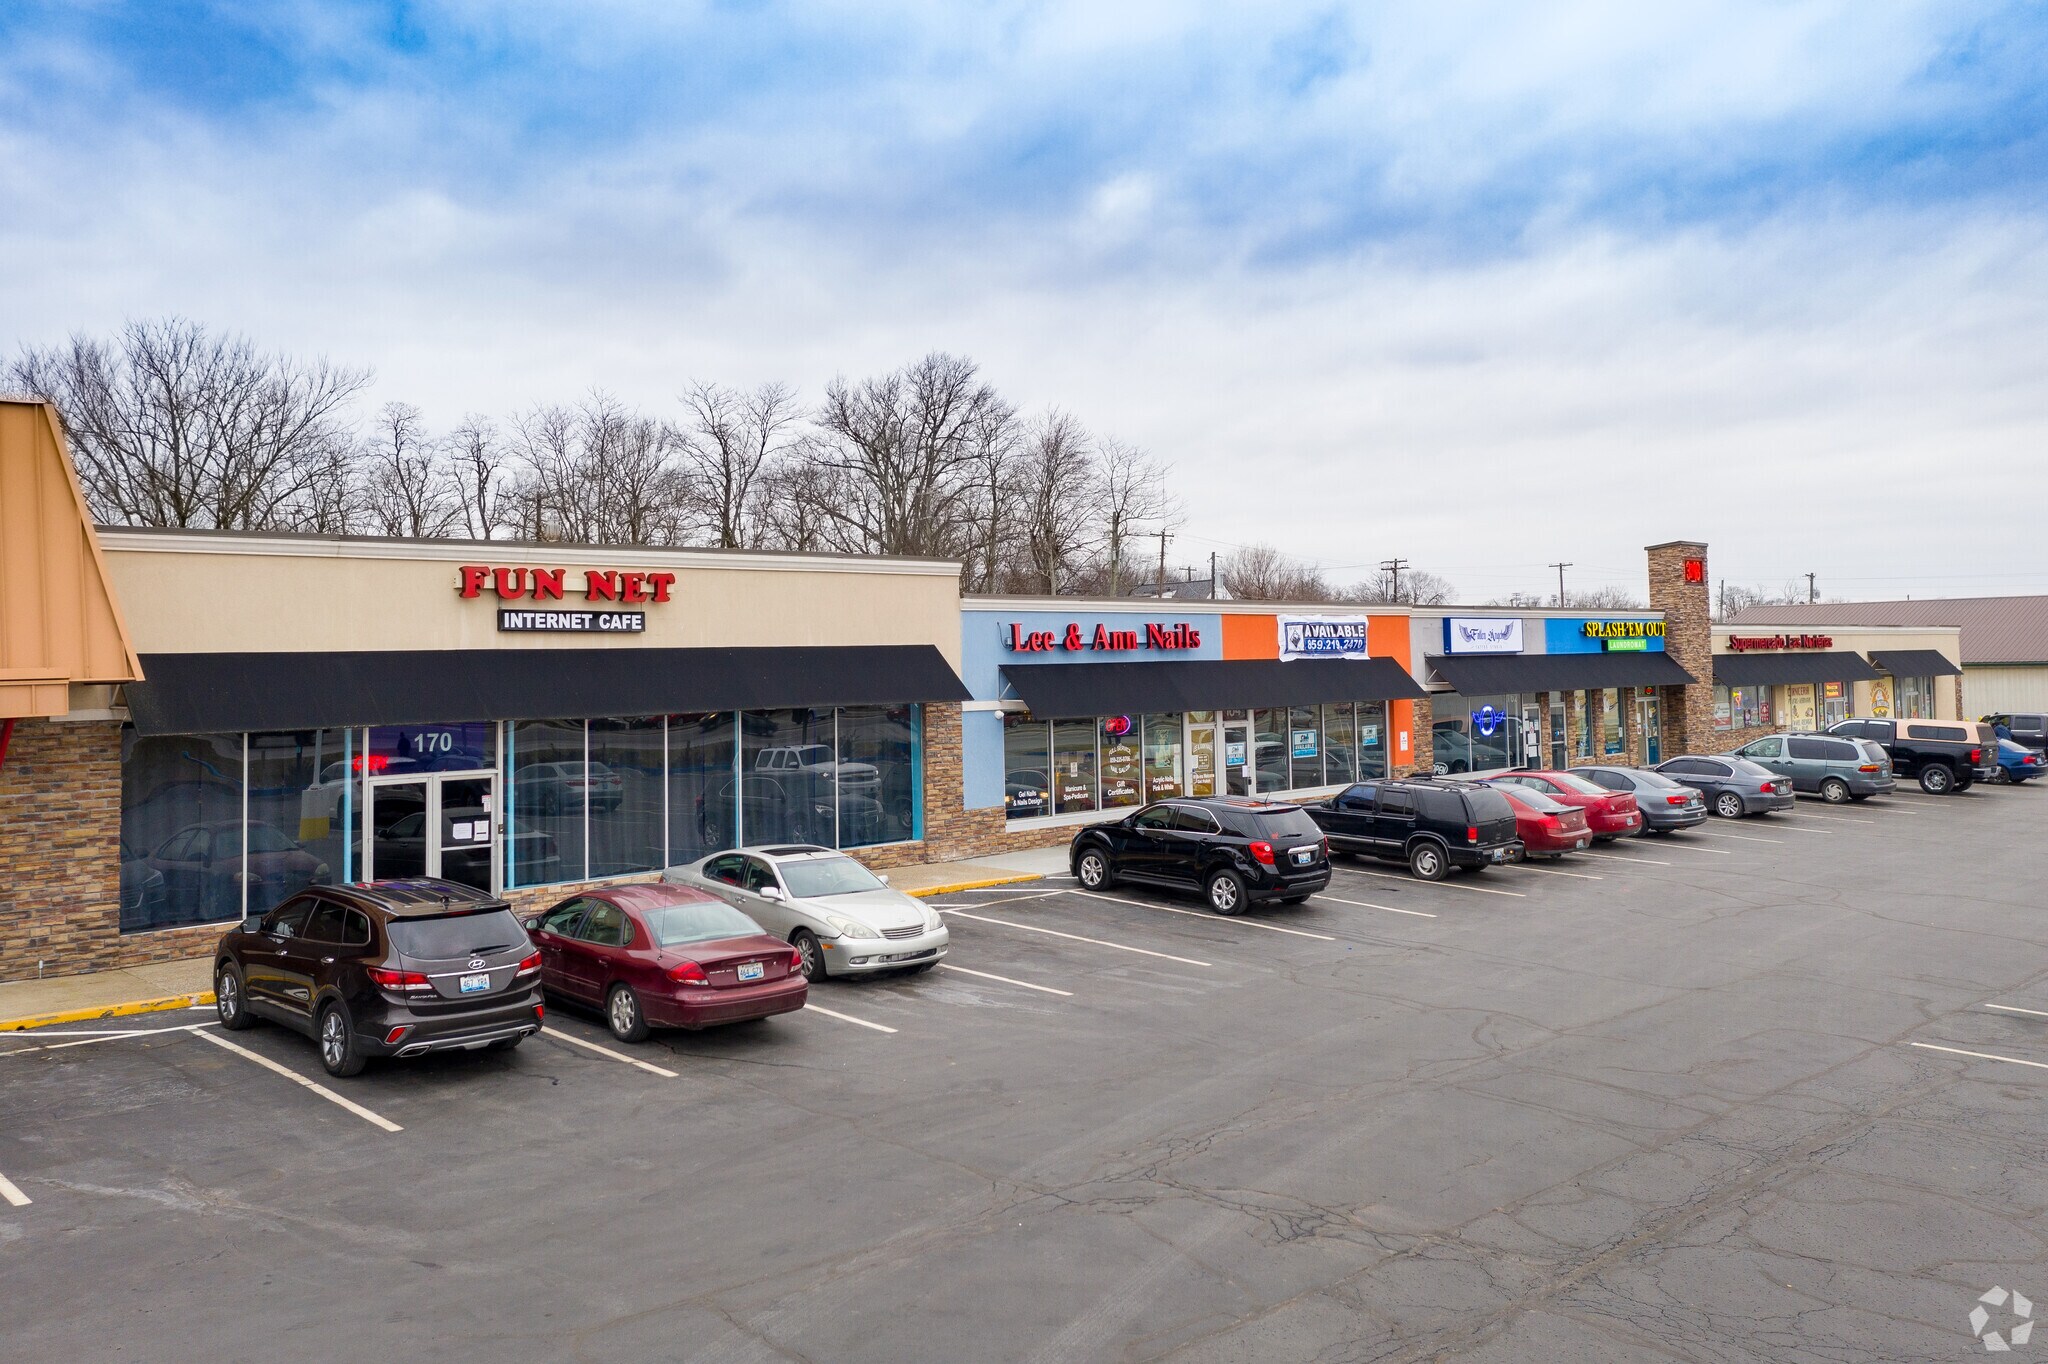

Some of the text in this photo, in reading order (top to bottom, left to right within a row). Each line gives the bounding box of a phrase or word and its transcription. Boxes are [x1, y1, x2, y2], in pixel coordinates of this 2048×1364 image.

[458, 565, 676, 603] FUN NET
[504, 612, 642, 630] INTERNET CAFE
[1304, 624, 1365, 638] AVAILABLE
[1585, 620, 1667, 637] SPLASH'EM OUT
[1009, 622, 1201, 652] Lee & Ann Nails
[1306, 638, 1363, 650] 859.219.2470
[1609, 640, 1646, 649] LAUNDROMAT
[1106, 718, 1127, 732] OPEN
[414, 732, 452, 752] 170
[1107, 788, 1134, 797] Certificates
[1028, 798, 1042, 806] Design
